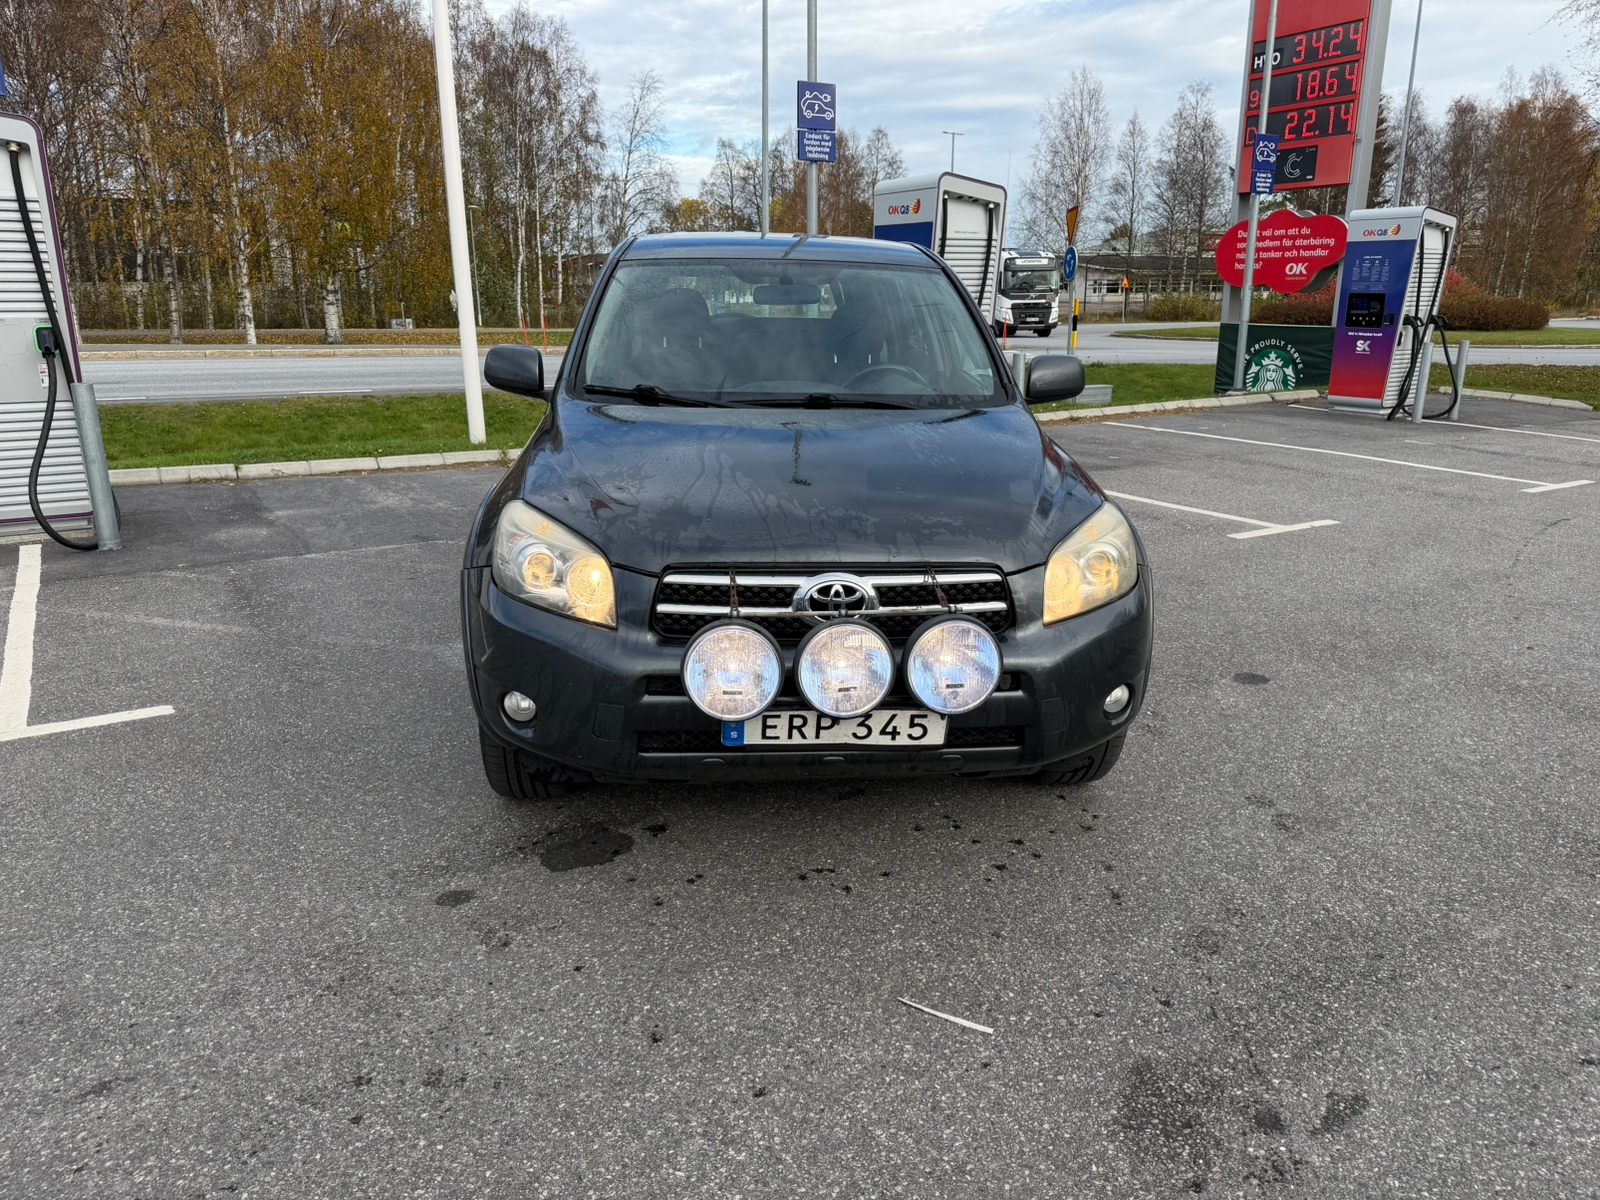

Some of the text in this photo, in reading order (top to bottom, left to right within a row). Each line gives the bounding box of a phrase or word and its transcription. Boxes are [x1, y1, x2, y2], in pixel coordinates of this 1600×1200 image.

[1254, 22, 1364, 69] HO 34.24
[1296, 63, 1359, 100] 18.64
[1285, 103, 1354, 139] 22.14
[1261, 228, 1273, 237] väl
[1287, 227, 1300, 236] att
[1300, 226, 1311, 235] du
[1282, 238, 1294, 247] får
[1294, 237, 1335, 247] återbäring
[1259, 250, 1283, 258] tankar
[1284, 249, 1298, 258] och
[1299, 248, 1329, 257] handlar
[1285, 262, 1309, 275] OK
[1355, 340, 1372, 351] SK
[1250, 338, 1286, 354] PROUDLY
[1286, 344, 1304, 370] SERVE
[760, 713, 929, 741] ERP 345
[730, 730, 738, 739] S
